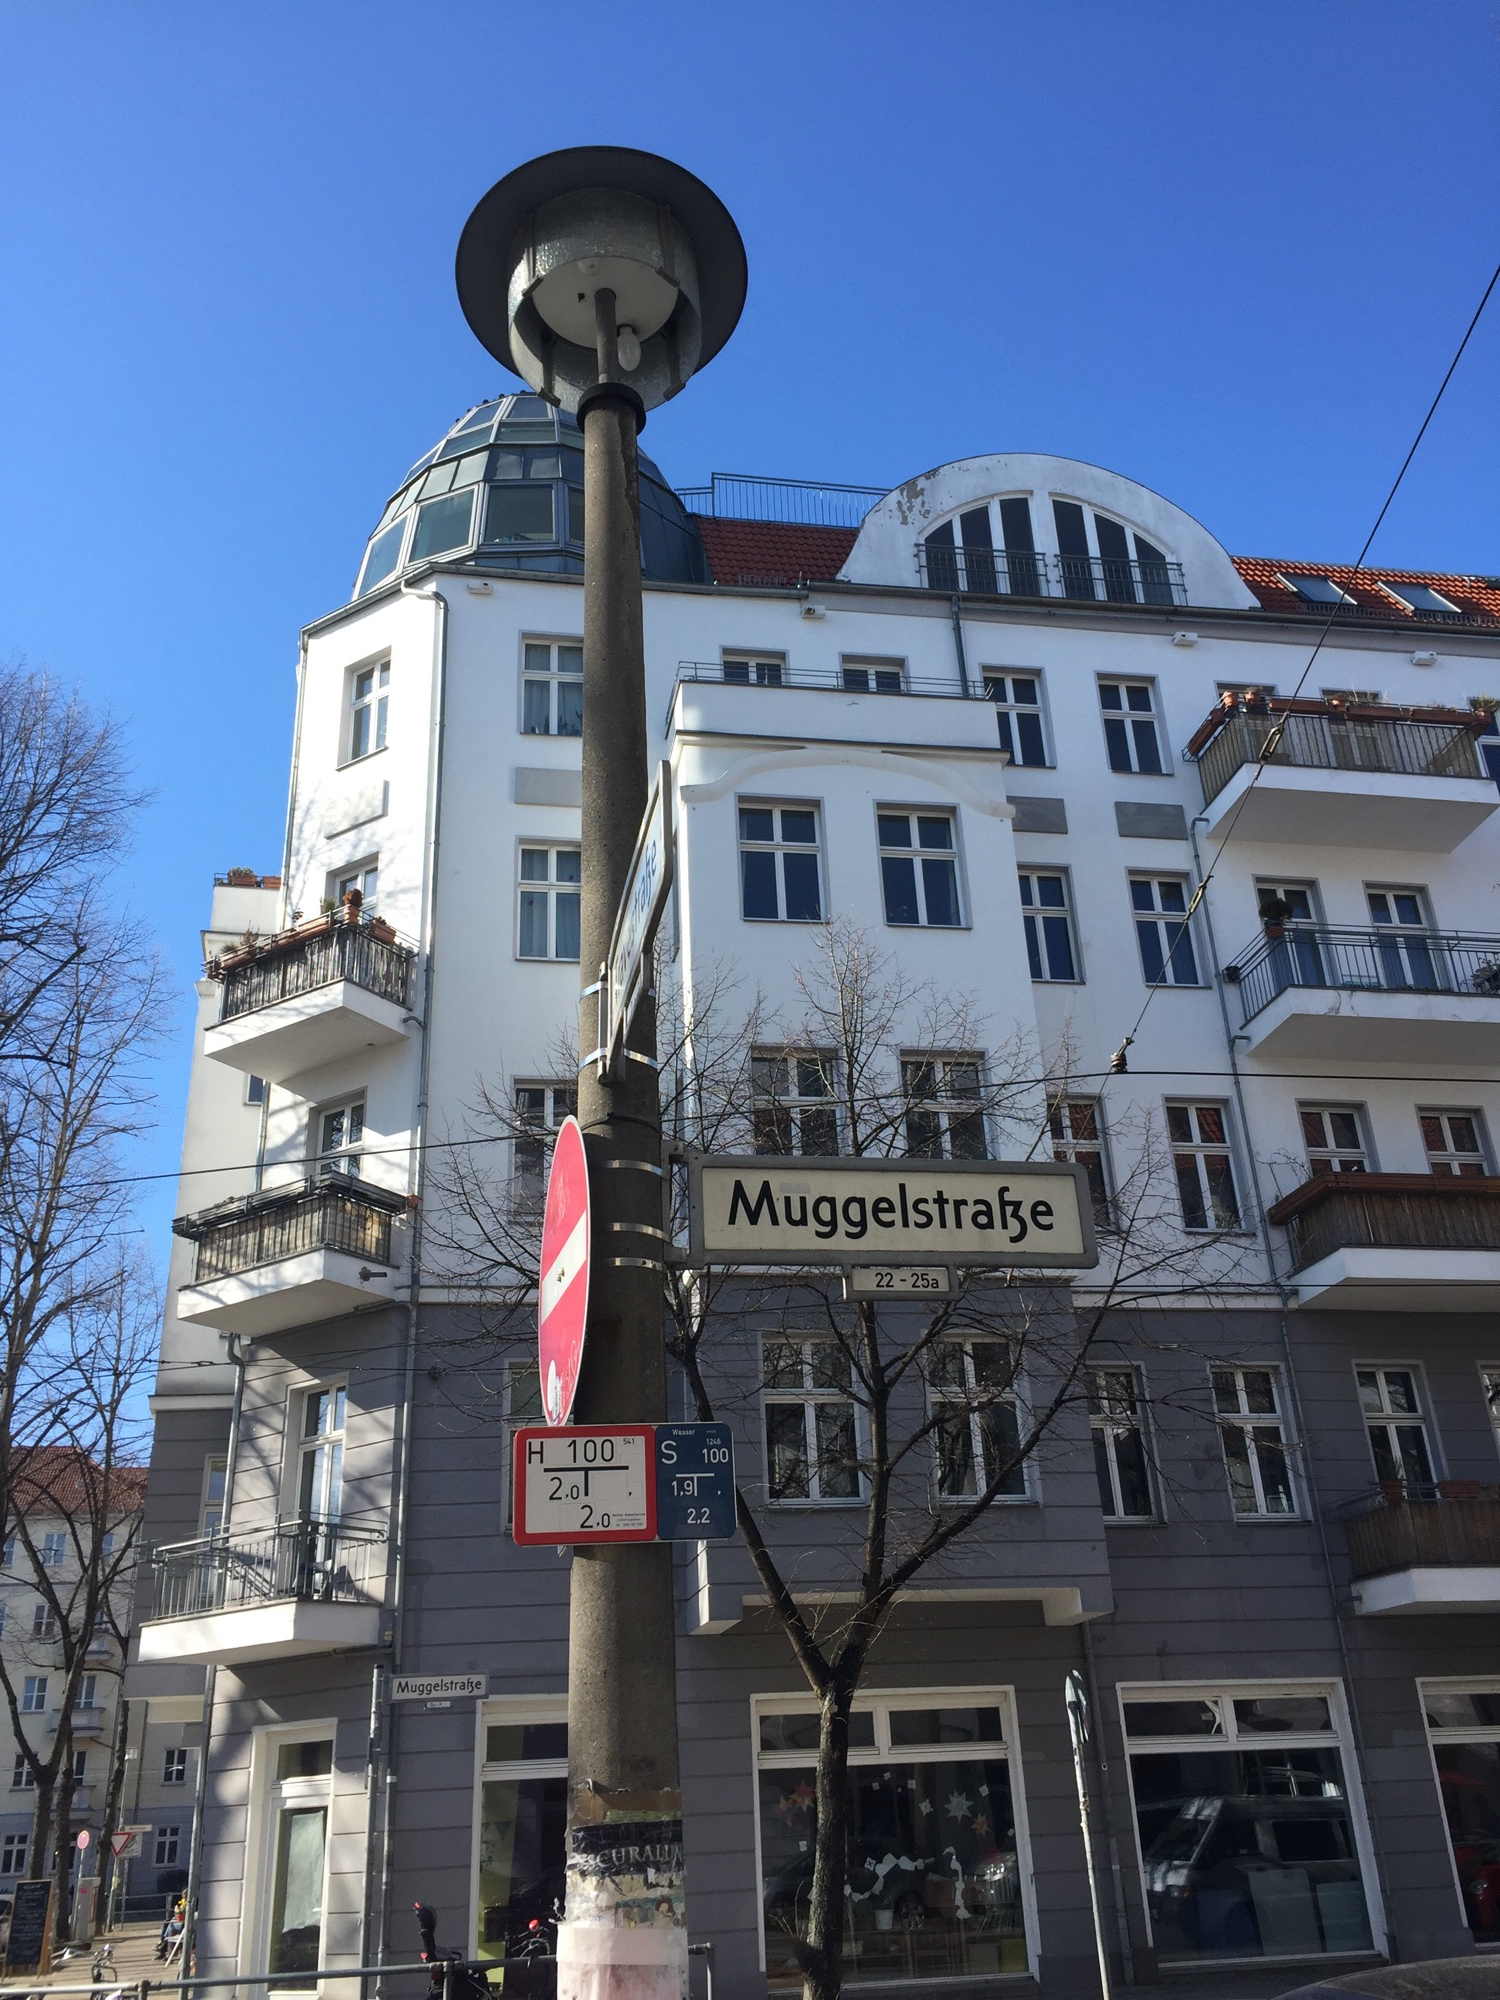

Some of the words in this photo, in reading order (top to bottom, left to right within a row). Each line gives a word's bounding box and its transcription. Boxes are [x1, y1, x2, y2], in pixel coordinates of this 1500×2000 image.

[875, 1272, 894, 1288] 22
[910, 1272, 940, 1289] 25a
[528, 1441, 544, 1464] H
[567, 1439, 614, 1464] 100
[661, 1440, 677, 1464] S
[702, 1448, 729, 1464] 100
[687, 1507, 710, 1524] 2,2
